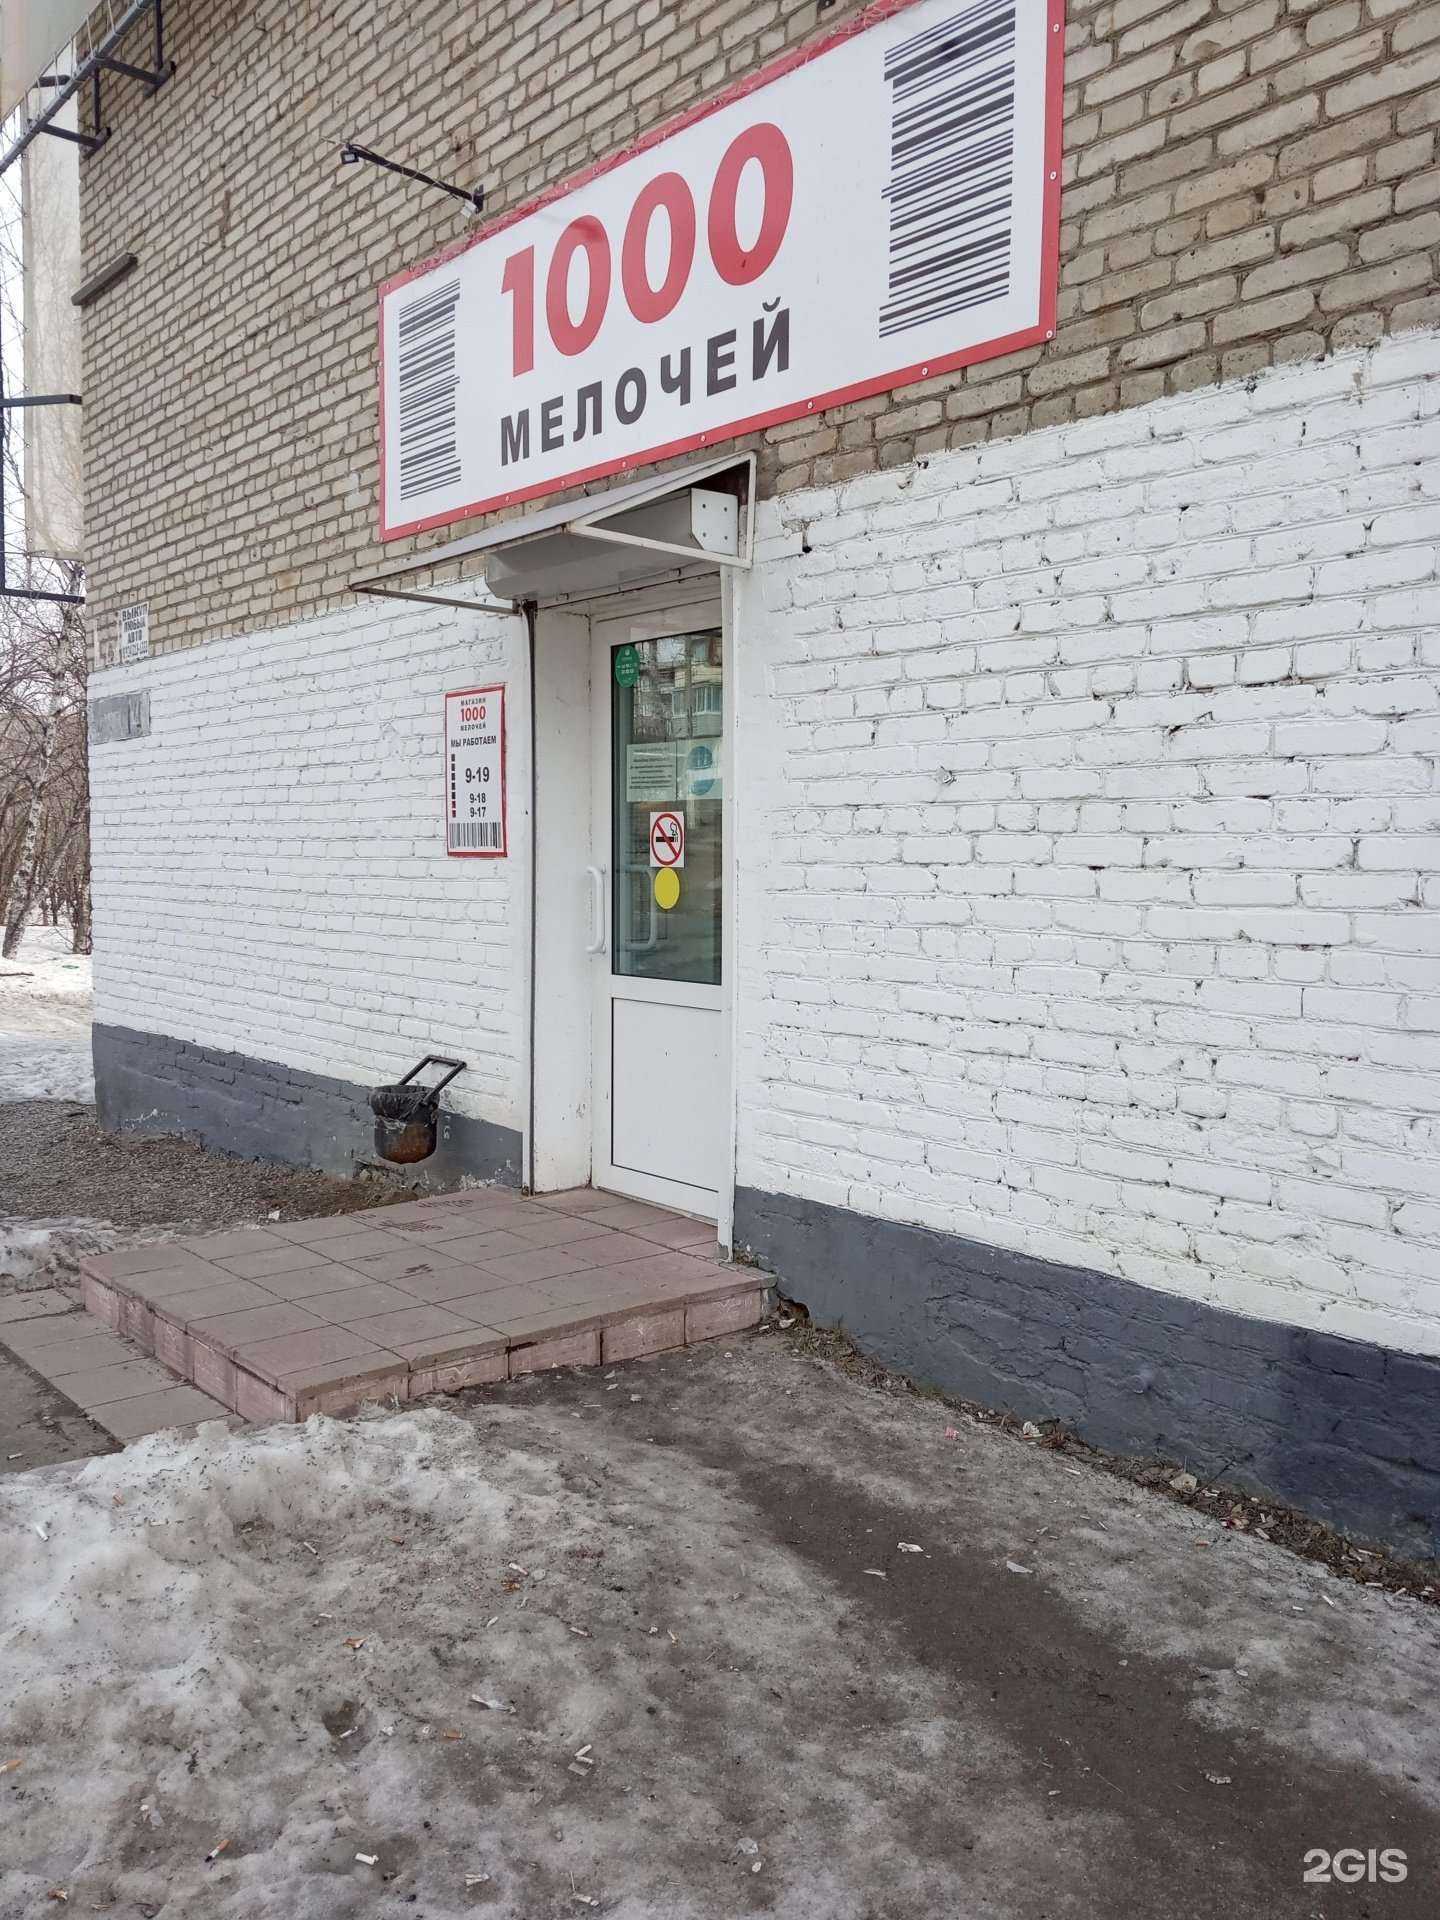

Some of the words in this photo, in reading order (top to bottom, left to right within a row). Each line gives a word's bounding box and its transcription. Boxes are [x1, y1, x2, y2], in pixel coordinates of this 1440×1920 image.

[501, 122, 793, 378] 1000
[500, 297, 790, 467] МЕЛОЧЕЙ
[122, 603, 147, 621] ВЫКУП
[461, 698, 486, 706] МАГАЗИН
[461, 705, 486, 722] 1000
[460, 722, 486, 731] МЕЛОЧЕЙ
[451, 738, 461, 747] МЫ
[463, 735, 496, 747] РАБОТАЕМ
[465, 766, 490, 783] 9-19
[469, 792, 486, 803] 9-18
[470, 806, 486, 818] 9-17
